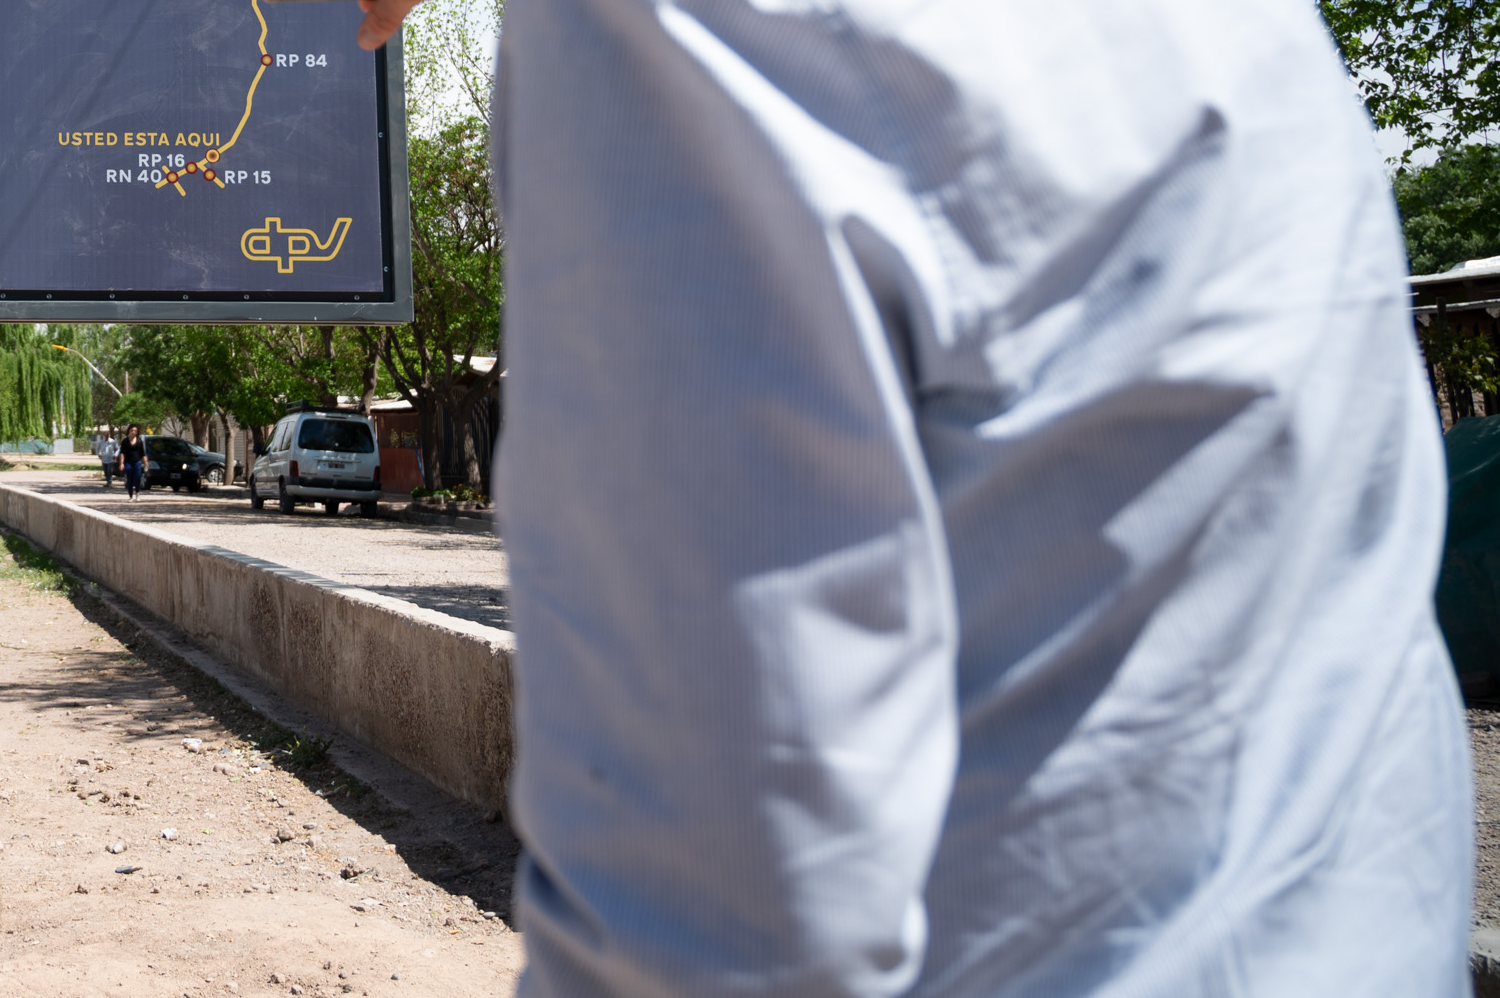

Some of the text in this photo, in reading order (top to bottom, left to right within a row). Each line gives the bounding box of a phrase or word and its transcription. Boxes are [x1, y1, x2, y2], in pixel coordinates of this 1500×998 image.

[276, 54, 328, 67] RP 84
[58, 132, 220, 147] USTED ESTA AQUI
[138, 154, 185, 167] RP 16
[106, 169, 162, 184] RN 40
[225, 171, 272, 184] RP 15
